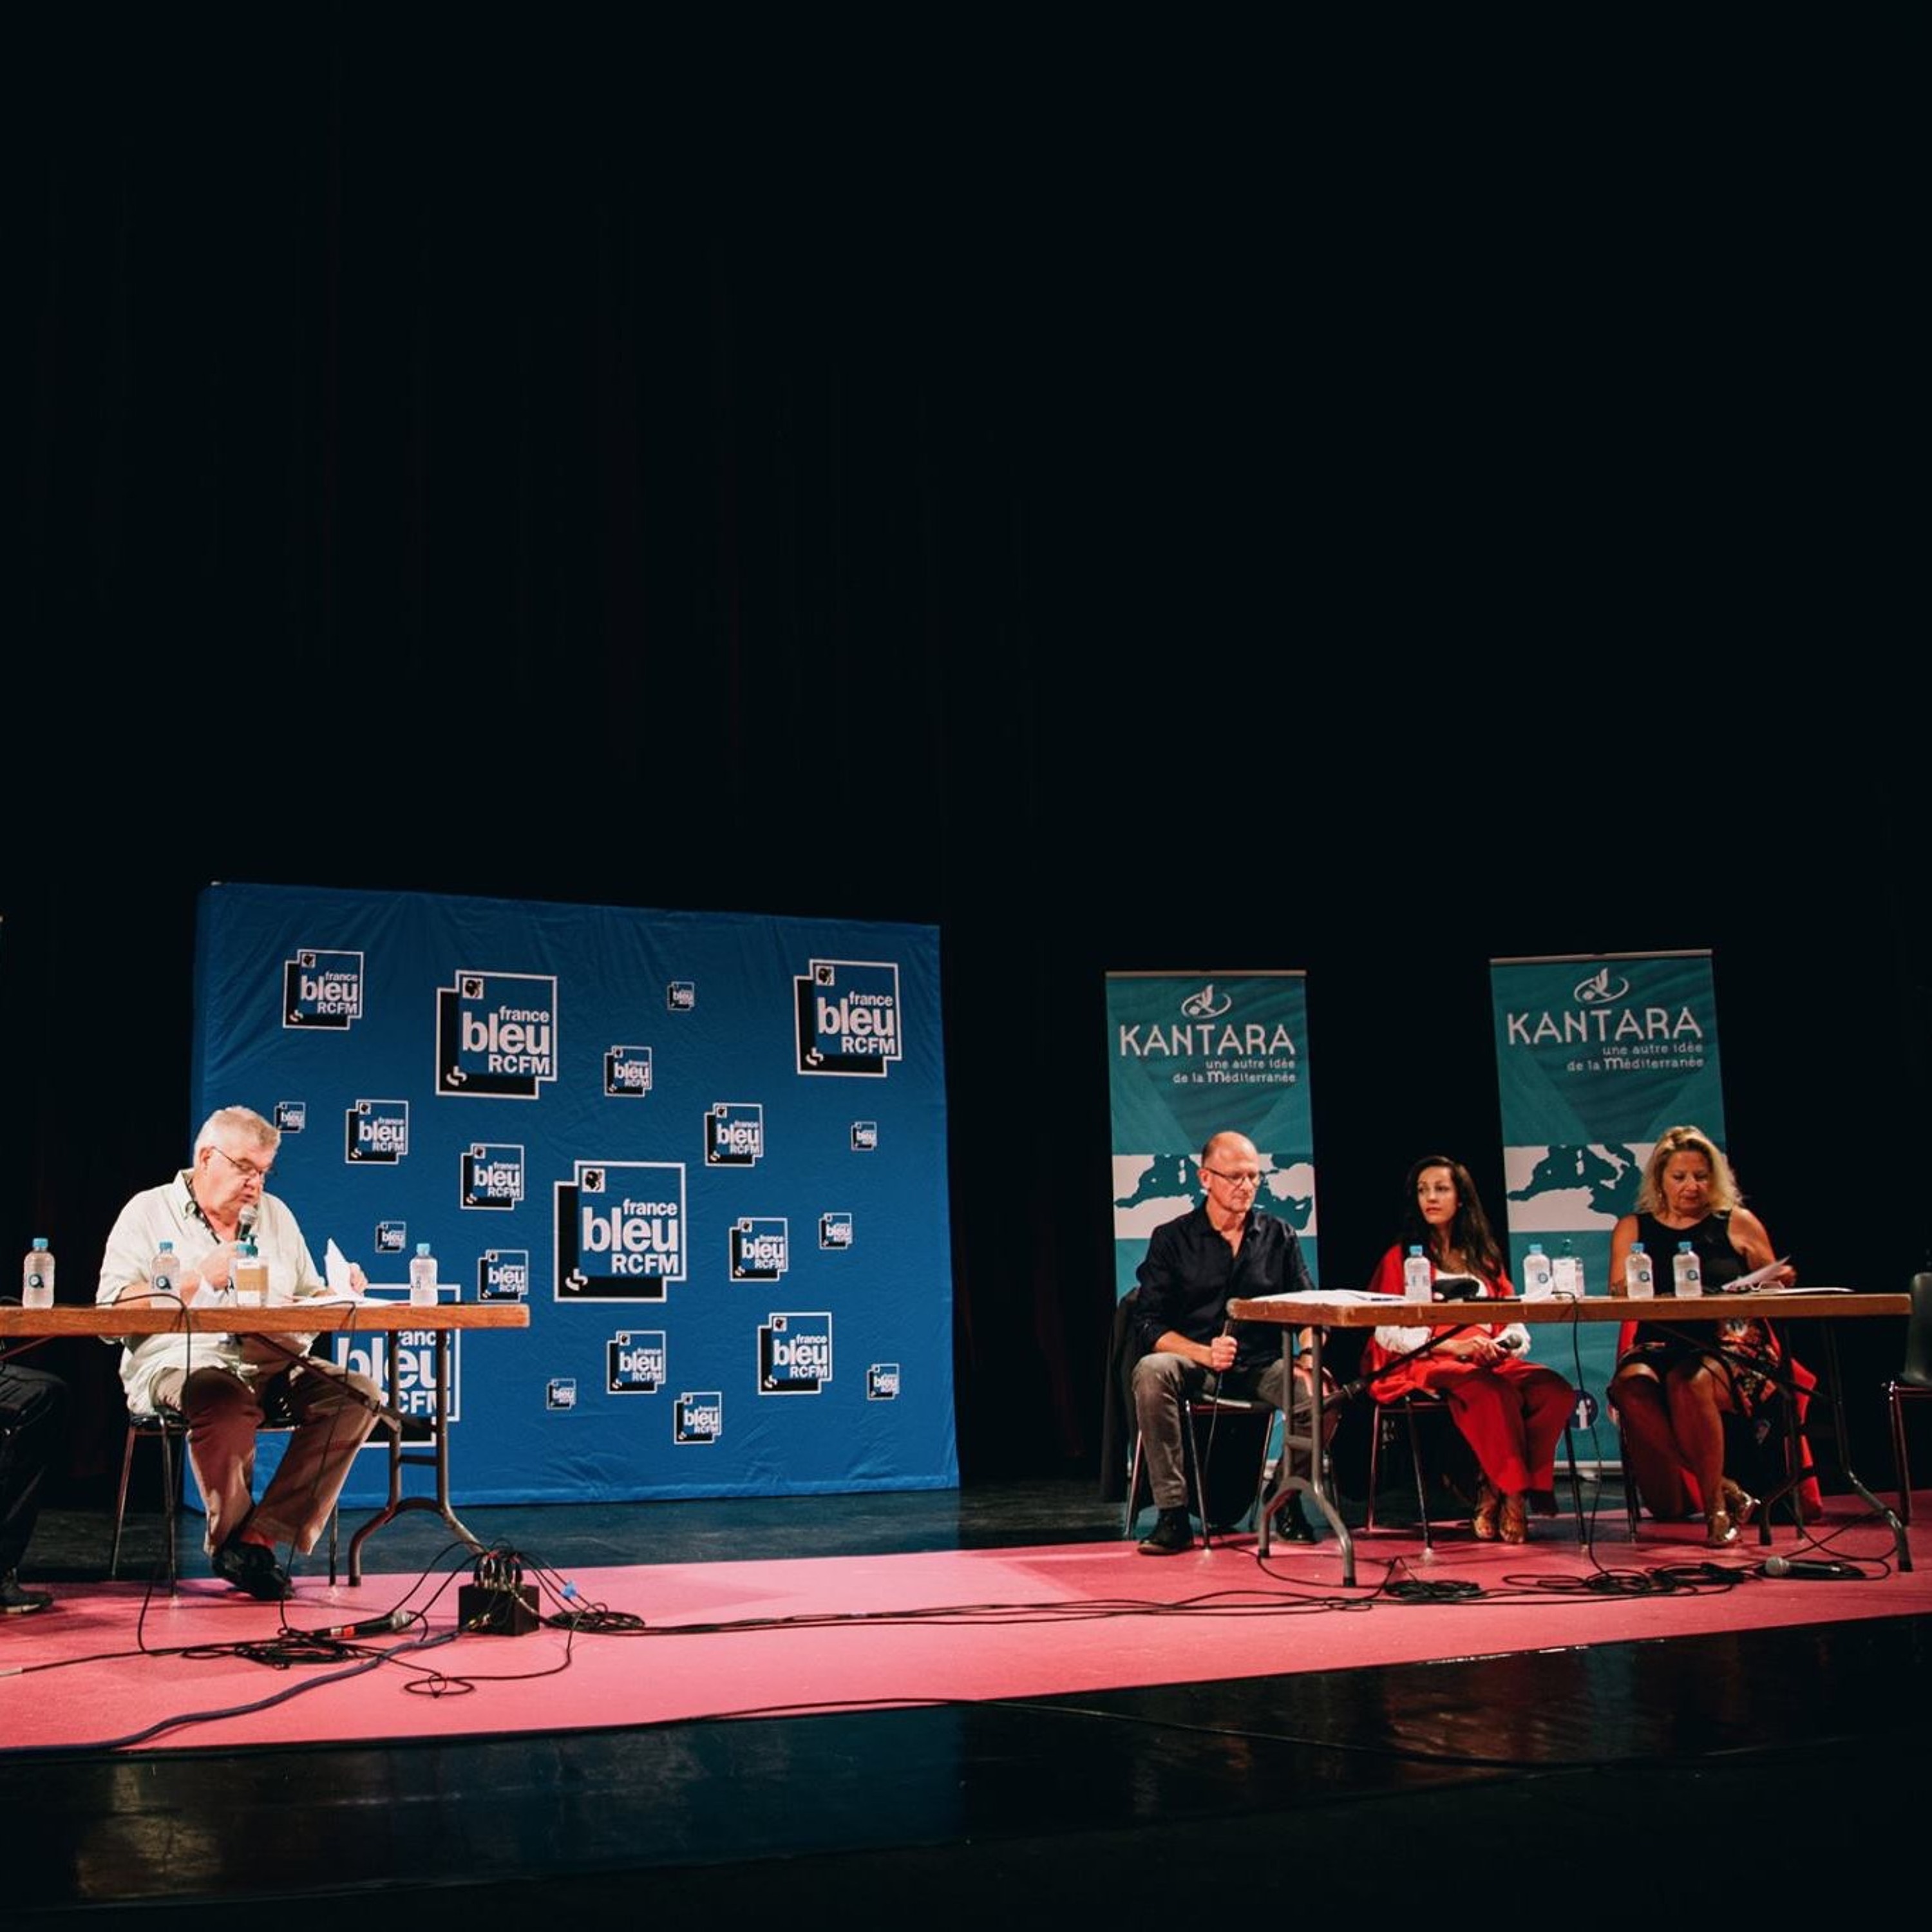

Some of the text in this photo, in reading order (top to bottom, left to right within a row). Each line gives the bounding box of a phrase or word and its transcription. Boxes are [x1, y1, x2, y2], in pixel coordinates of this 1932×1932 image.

[325, 971, 357, 983] france
[301, 976, 357, 1001] bleu
[317, 1001, 357, 1014] RCFM
[848, 991, 893, 1007] france
[499, 1006, 549, 1023] france
[817, 997, 894, 1036] bleu
[462, 1012, 550, 1054] bleu
[1508, 1007, 1703, 1045] KANTARA
[842, 1036, 895, 1054] RCFM
[1121, 1025, 1295, 1056] KANTARA
[1603, 1046, 1627, 1055] une
[1632, 1045, 1669, 1054] autre
[488, 1054, 550, 1074] RCFM
[614, 1062, 649, 1079] bleu
[1232, 1060, 1264, 1068] autre
[1567, 1061, 1584, 1072] de
[1588, 1060, 1600, 1070] la
[1173, 1074, 1188, 1083] de
[1193, 1072, 1204, 1083] la
[359, 1121, 404, 1142] bleu
[717, 1124, 759, 1145] bleu
[373, 1141, 404, 1151] RCFM
[730, 1144, 760, 1154] RCFM
[474, 1166, 520, 1186] bleu
[488, 1186, 520, 1197] RCFM
[623, 1198, 677, 1216] france
[583, 1207, 678, 1251] bleu
[742, 1239, 784, 1260] bleu
[612, 1253, 678, 1274] RCFM
[755, 1259, 785, 1269] RCFM
[488, 1267, 525, 1284] bleu
[796, 1335, 827, 1344] france
[774, 1340, 828, 1365] bleu
[620, 1352, 661, 1372] bleu
[632, 1372, 661, 1381] RCFM
[790, 1365, 828, 1378] RCFM
[684, 1409, 719, 1426] bleu
